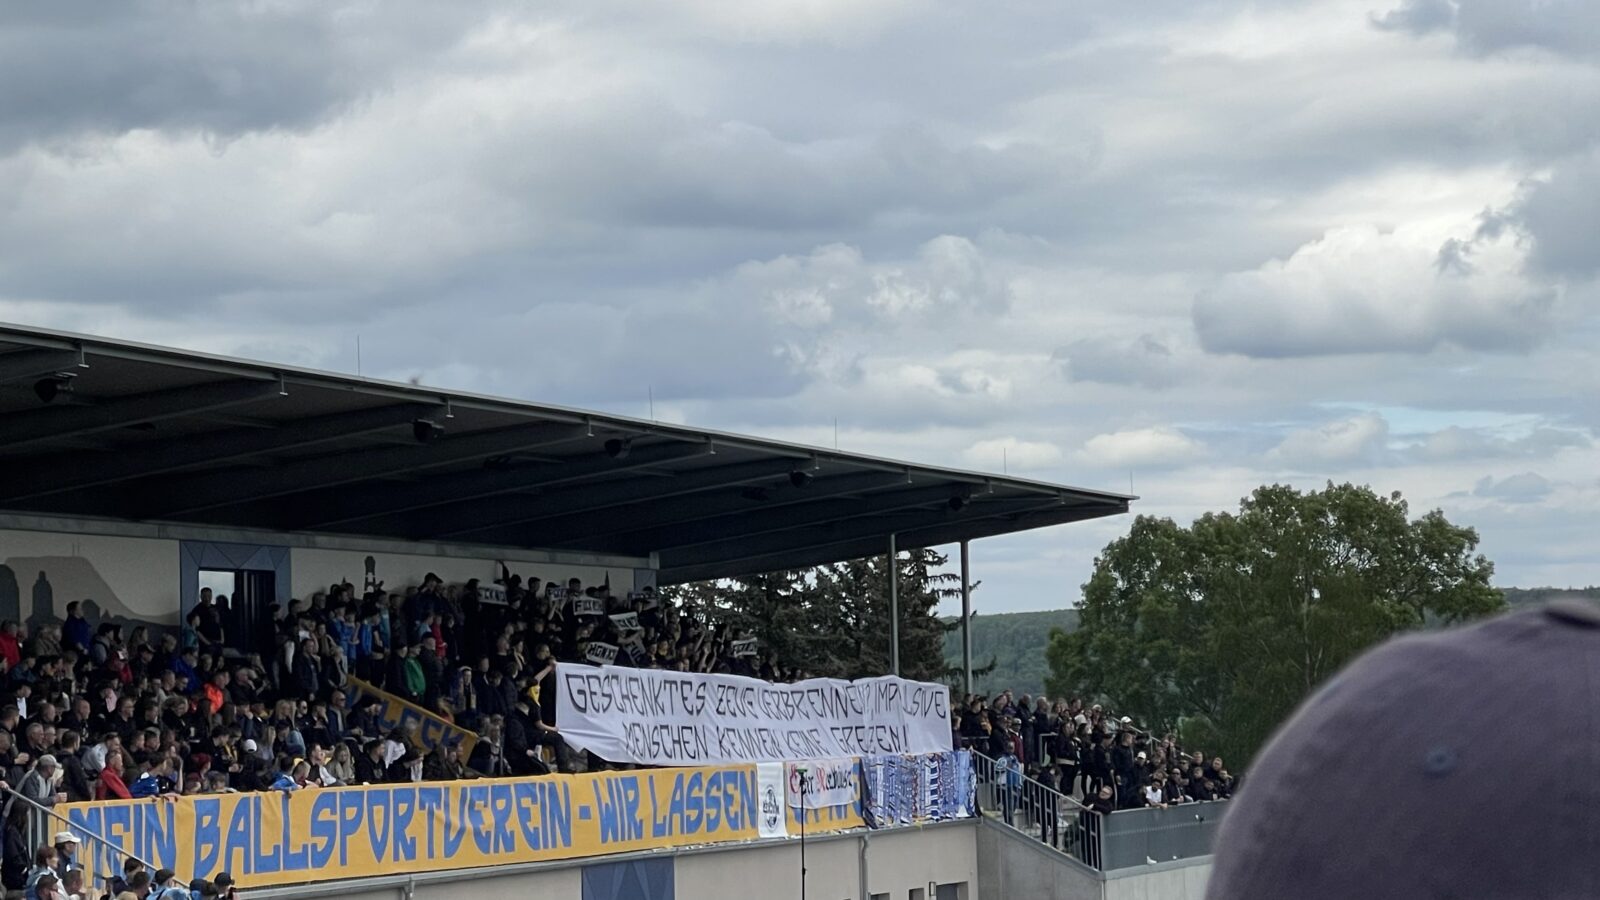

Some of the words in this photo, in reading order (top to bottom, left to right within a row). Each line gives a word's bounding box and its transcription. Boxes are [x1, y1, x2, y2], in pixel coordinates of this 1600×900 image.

[565, 673, 706, 717] GESCHENKTES
[715, 684, 758, 719] ZEUG
[622, 721, 709, 760] MENSCHEN
[715, 725, 785, 760] KENNEN
[785, 728, 830, 759] KEINE
[193, 781, 572, 880] BALLSPORTVEREIN
[593, 775, 644, 844] WIR
[650, 770, 757, 838] LASSEN
